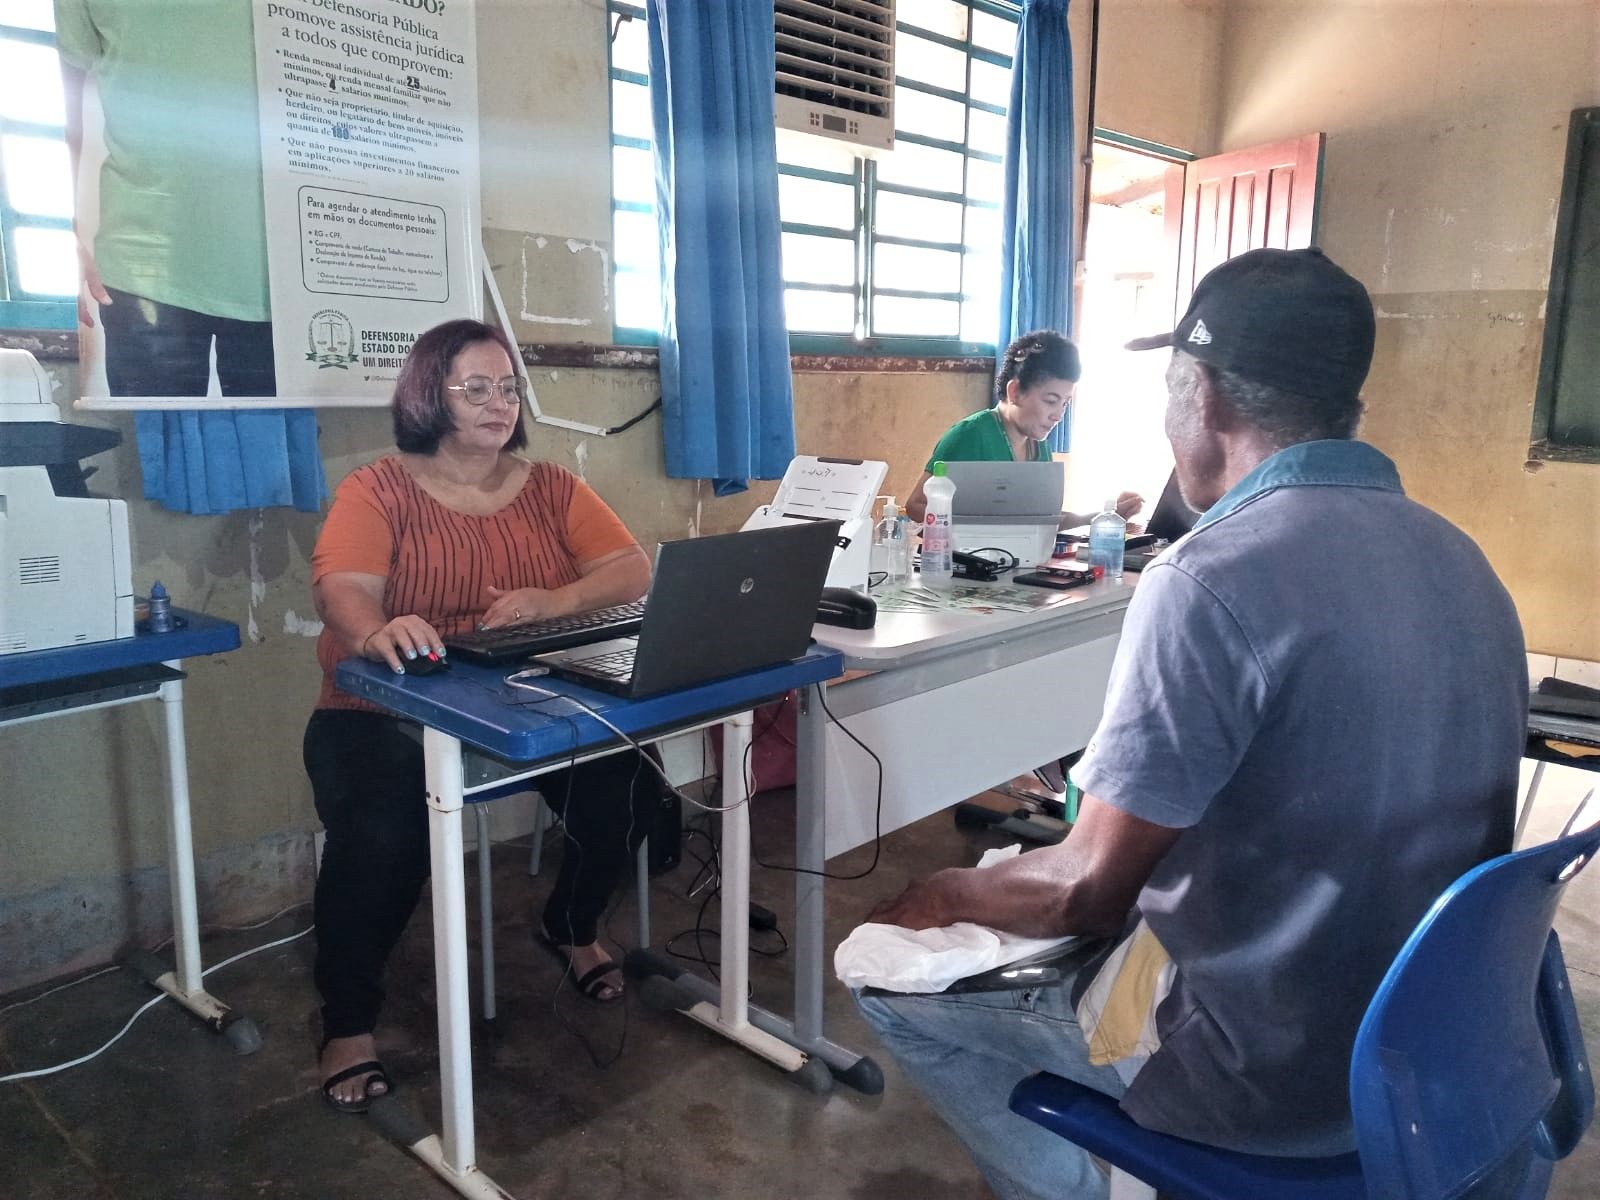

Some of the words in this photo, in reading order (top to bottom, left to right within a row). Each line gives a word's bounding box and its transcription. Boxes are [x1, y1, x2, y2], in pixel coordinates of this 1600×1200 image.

[267, 3, 336, 30] promove
[340, 22, 412, 51] assistência
[416, 41, 465, 64] jurídica
[393, 15, 439, 41] Pública
[281, 26, 290, 38] a
[295, 29, 337, 49] todos
[341, 42, 368, 57] que
[371, 49, 453, 79] comprovem:
[283, 49, 311, 62] Renda
[312, 57, 342, 70] mensal
[343, 64, 383, 80] individual
[385, 74, 394, 83] de
[284, 72, 327, 88] ultrapasse
[338, 75, 362, 86] renda
[363, 80, 391, 93] mensal
[393, 86, 422, 100] familiar
[422, 95, 436, 104] que
[285, 87, 304, 98] Que
[305, 92, 321, 102] não
[323, 97, 340, 107] seja
[392, 111, 415, 122] titular
[416, 116, 425, 125] de
[287, 121, 319, 134] quantia
[321, 127, 332, 136] de
[359, 125, 387, 137] valores
[376, 118, 386, 127] de
[388, 120, 405, 130] bens
[287, 136, 306, 147] Que
[309, 141, 325, 150] não
[328, 145, 358, 156] possua
[360, 151, 416, 167] investimentos
[417, 160, 460, 175] financeiros
[288, 149, 302, 157] em
[353, 160, 396, 173] superiores
[404, 168, 414, 177] 20
[307, 196, 325, 209] Para
[328, 201, 359, 212] agendar
[370, 207, 416, 221] atendimento
[417, 213, 437, 225] tenha
[307, 211, 321, 219] em
[323, 212, 345, 223] mãos
[358, 215, 404, 231] documentos
[361, 330, 415, 342] DEFENSORIA
[362, 342, 395, 354] ESTADO
[398, 344, 411, 354] DO
[362, 356, 376, 367] UM
[378, 357, 406, 368] DIREIT
